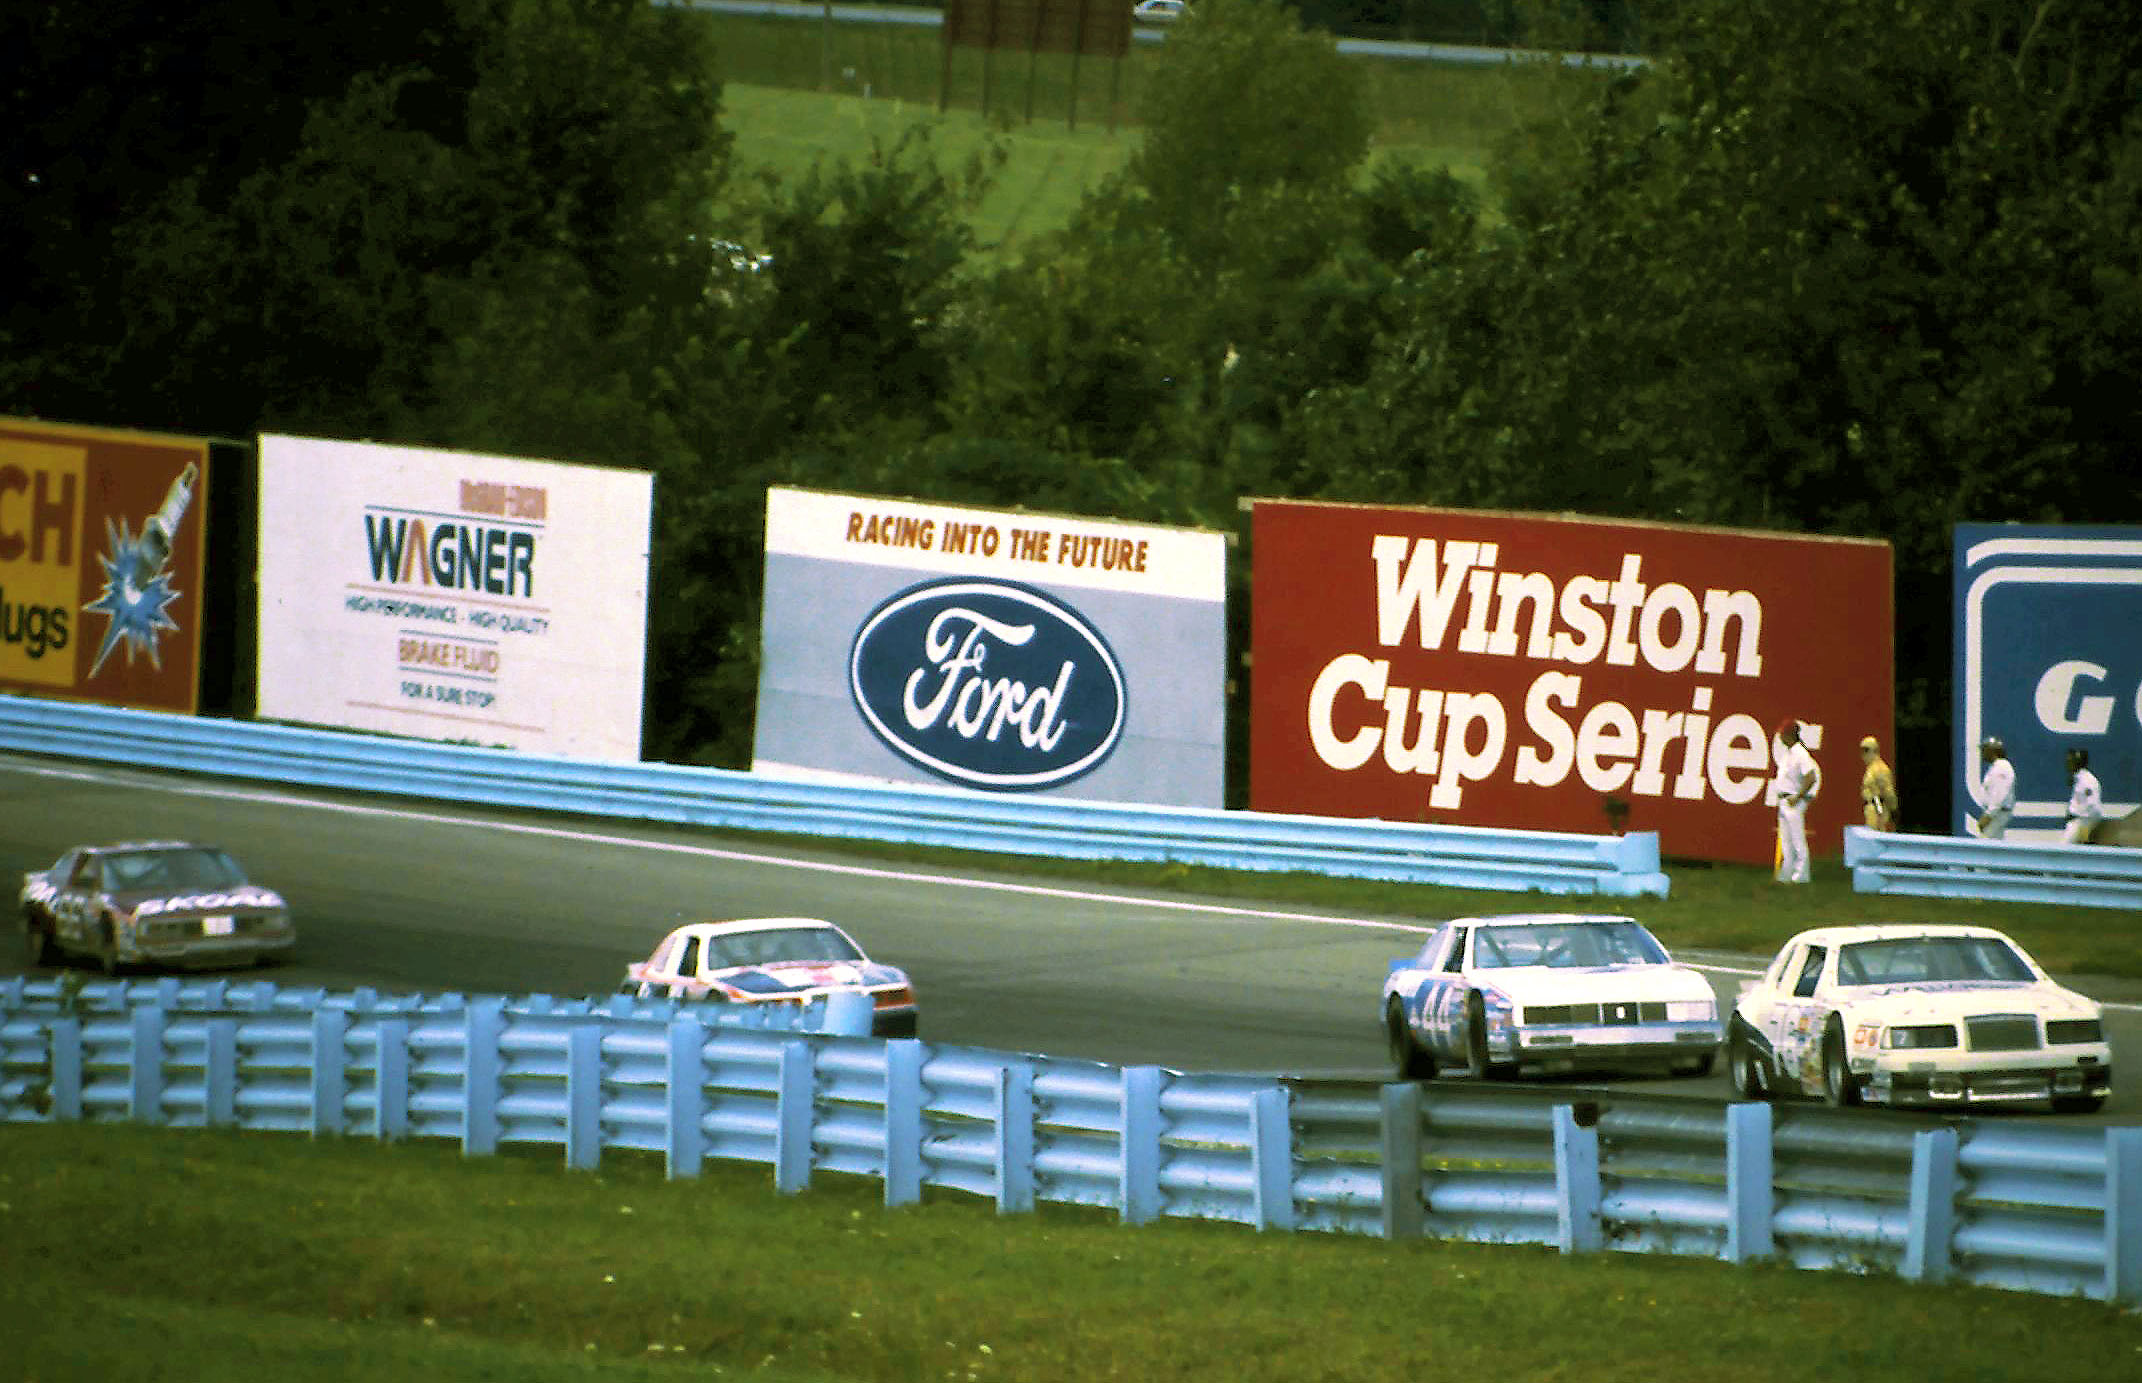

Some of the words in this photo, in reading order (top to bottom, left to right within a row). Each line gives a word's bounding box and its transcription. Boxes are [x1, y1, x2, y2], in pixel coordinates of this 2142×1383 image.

[364, 514, 535, 598] WAGNER
[846, 511, 935, 551] RACING
[941, 520, 1000, 558] INTO
[1010, 528, 1051, 563] THE
[1057, 533, 1149, 573] FUTURE
[1371, 534, 1764, 678] Winston
[399, 639, 449, 667] BRAKE
[454, 645, 499, 674] FLUID
[902, 606, 1077, 753] Ford
[2034, 660, 2142, 734] G
[1307, 653, 1508, 810] Cup
